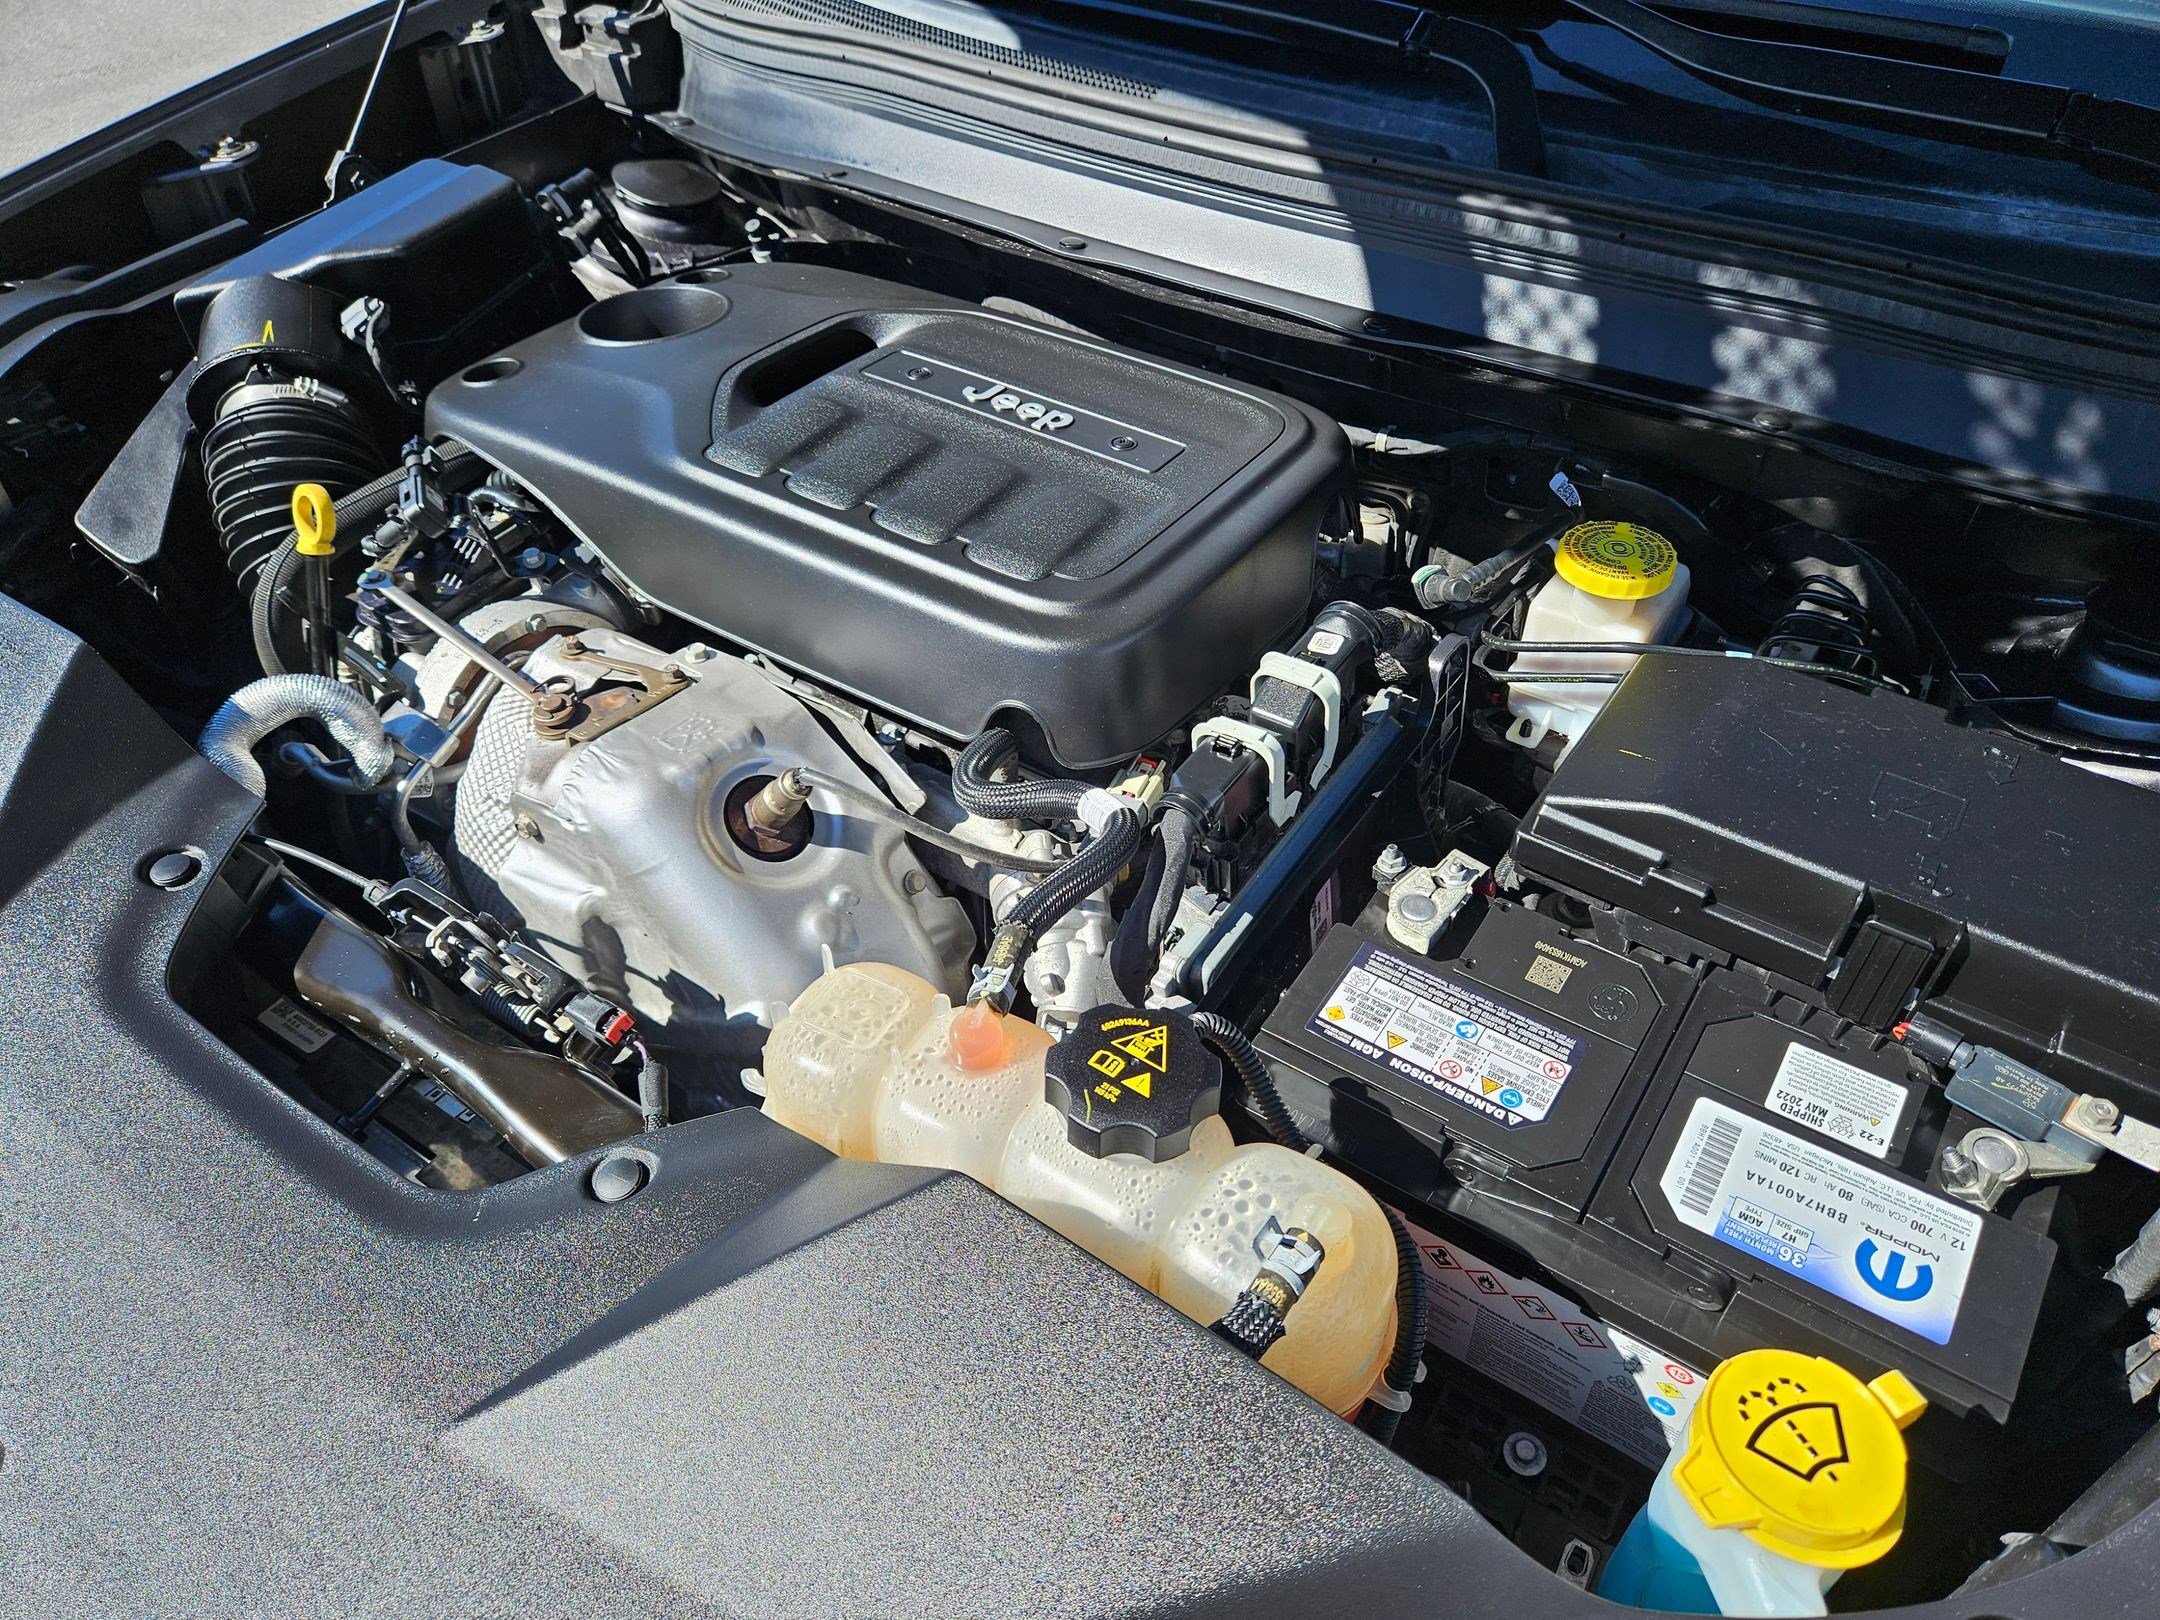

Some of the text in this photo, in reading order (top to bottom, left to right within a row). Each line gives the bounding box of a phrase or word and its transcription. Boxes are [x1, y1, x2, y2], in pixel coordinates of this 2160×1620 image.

[962, 384, 1074, 430] Jeep
[1356, 992, 1370, 1001] HELP
[1373, 987, 1387, 996] OPEN
[1387, 994, 1398, 1002] NOT
[1370, 999, 1392, 1011] MEDICAL
[1431, 995, 1443, 1003] NOT
[1447, 995, 1469, 1008] FOLLOW
[1350, 1005, 1384, 1024] IMMEDIATELY
[1374, 1009, 1388, 1018] WITH
[1349, 1013, 1379, 1030] FLUSH EYES
[1417, 1021, 1438, 1034] SEVERE
[1438, 1018, 1452, 1027] READ
[1394, 1018, 1443, 1044] CAUSE BLINDNESS
[1517, 1027, 1558, 1049] RECOMMENDED
[1410, 1042, 1435, 1057] SULFURIC
[1414, 1036, 1439, 1050] ACID CAN
[1456, 1039, 1480, 1053] SMOKING
[1557, 1045, 1570, 1055] NOT
[1452, 1052, 1473, 1065] SPARKS
[1456, 1047, 1477, 1059] FLAMES
[1512, 1052, 1524, 1061] OUT
[1525, 1051, 1542, 1062] REACH
[1465, 1065, 1473, 1073] NO
[1525, 1058, 1539, 1068] KEEP
[1349, 1038, 1507, 1119] DANGER/POISON AGM
[1488, 1063, 1553, 1096] CAN CAUSE BLINDNESS
[1486, 1070, 1549, 1103] EYES EXPLOSIVE GASES
[1547, 1082, 1556, 1090] OR
[1525, 1097, 1545, 1110] SHIELD
[1776, 1089, 1827, 1117] MAY 2022
[1779, 1102, 1824, 1127] SHIPPED
[1762, 1131, 1782, 1144] 48326
[1858, 1129, 1884, 1145] E-22
[1786, 1141, 1800, 1151] USA
[1683, 1158, 1693, 1170] AA
[1753, 1150, 1777, 1165] MINS
[1803, 1148, 1833, 1166] Michigan
[1778, 1161, 1801, 1178] 120
[1674, 1175, 1686, 1189] 001
[1803, 1172, 1817, 1183] RC
[1852, 1170, 1876, 1185] Auburn
[1823, 1180, 1836, 1191] Ah
[1743, 1169, 1848, 1223] BBH7A001AA
[1837, 1187, 1853, 1201] 80
[1896, 1189, 1905, 1197] US
[1907, 1194, 1920, 1204] FCA
[1744, 1204, 1763, 1217] TYPE
[1860, 1196, 1885, 1213] (SAE)
[1738, 1210, 1763, 1228] AGM
[1887, 1208, 1907, 1223] CCA
[1935, 1206, 1973, 1227] Distributed
[1725, 1219, 1778, 1248] REPLACEMENT
[1774, 1218, 1809, 1237] GRP SIZE
[1909, 1219, 1933, 1237] 700
[1781, 1231, 1796, 1243] H7
[1939, 1232, 1947, 1240] V
[1722, 1225, 1807, 1269] 36 MONTH FREE
[1950, 1236, 1967, 1251] 12
